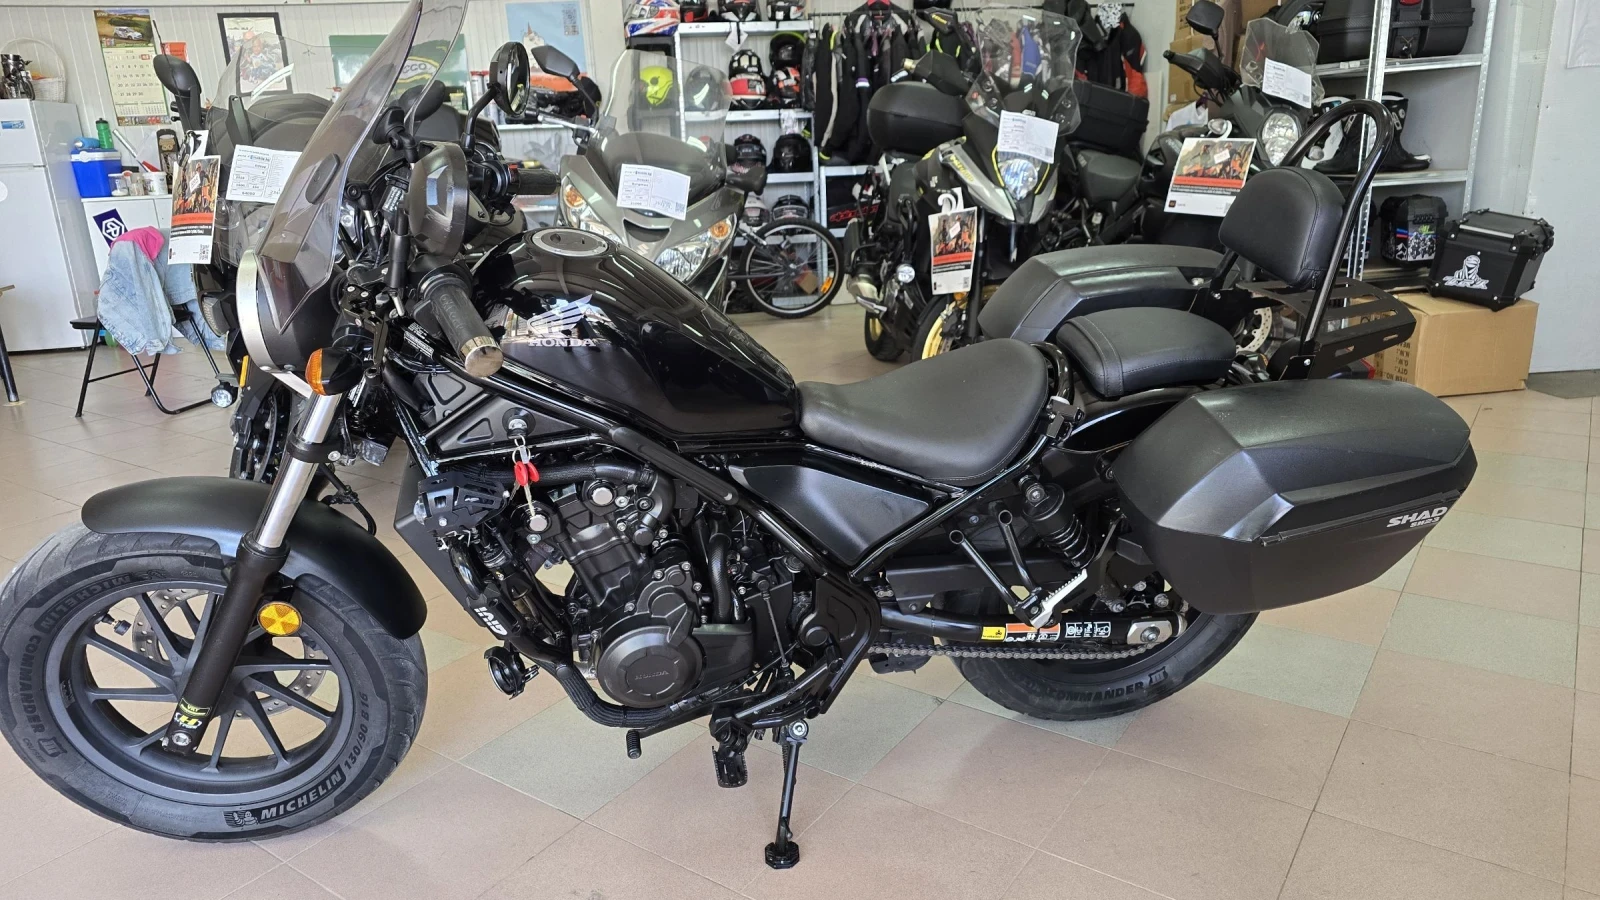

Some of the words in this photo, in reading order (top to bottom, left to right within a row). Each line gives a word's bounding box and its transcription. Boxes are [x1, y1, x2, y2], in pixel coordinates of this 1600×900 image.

[528, 338, 597, 347] HONDA
[1386, 506, 1448, 528] SHAD
[19, 635, 46, 734] COMMANDER
[634, 670, 670, 681] HONDA
[359, 691, 370, 709] 16
[361, 709, 370, 722] B
[344, 723, 369, 770] 130/90
[260, 769, 343, 820] MICHELIN
